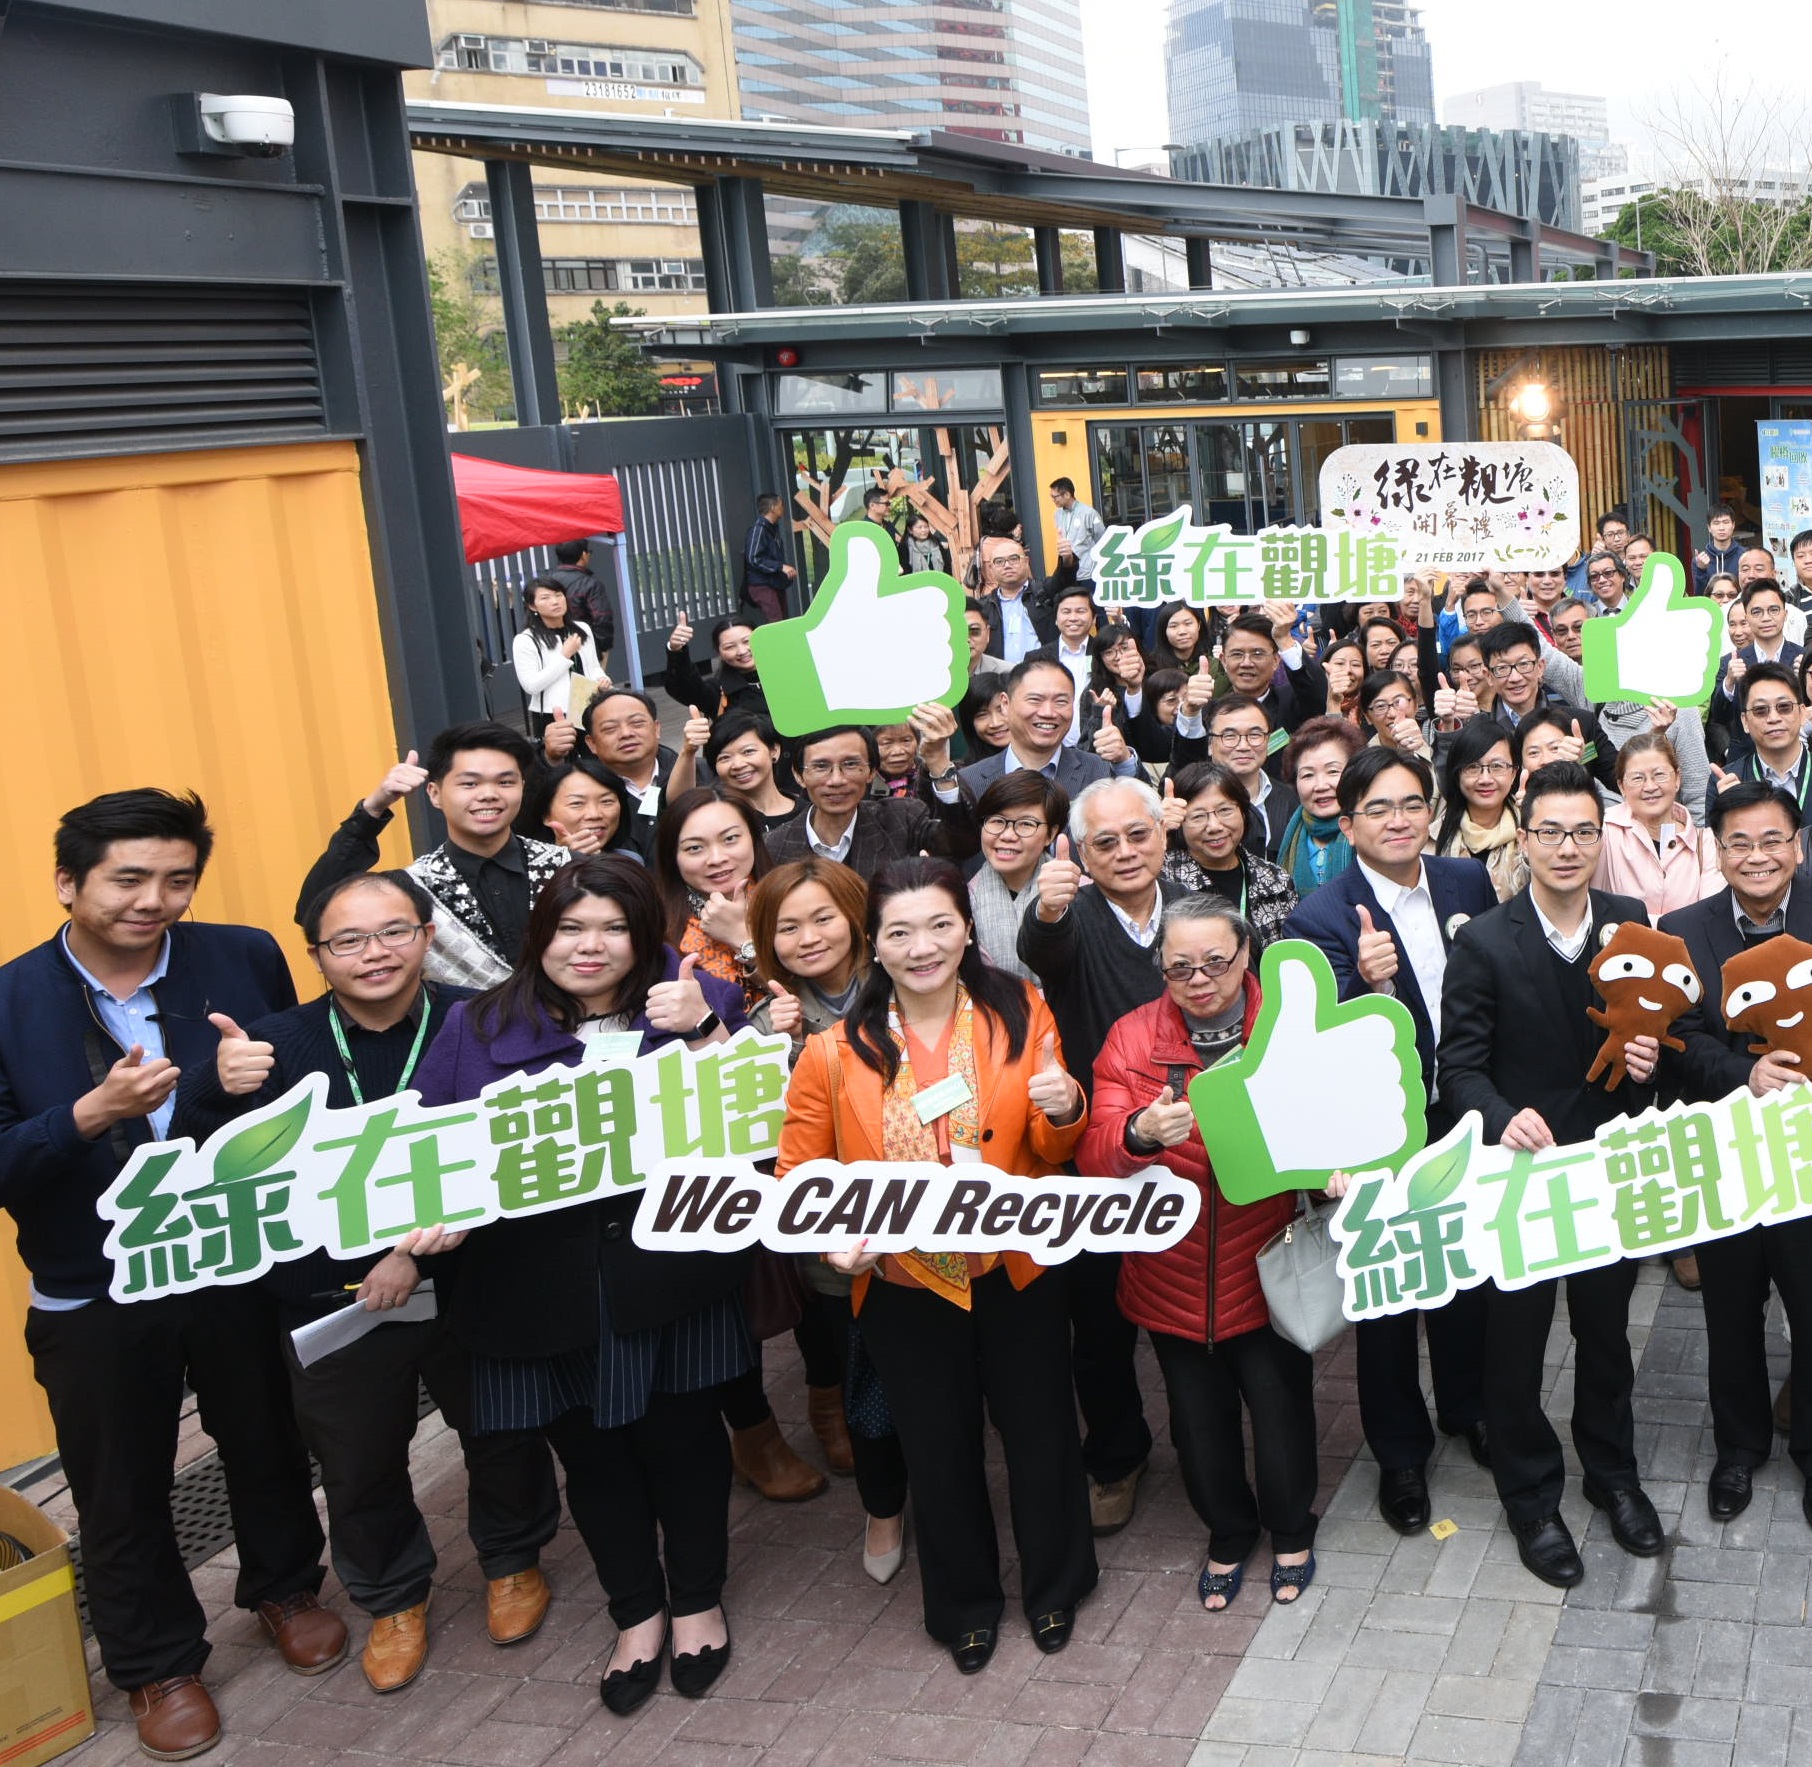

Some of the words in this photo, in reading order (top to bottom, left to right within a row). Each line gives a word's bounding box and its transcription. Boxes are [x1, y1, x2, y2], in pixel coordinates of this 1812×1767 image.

[584, 82, 637, 99] 23181652
[1413, 501, 1494, 543] 開幕禮
[1100, 516, 1399, 601] 綠在觀塘
[1415, 553, 1429, 563] 21
[1433, 552, 1454, 563] FEB
[1457, 552, 1485, 563] 2017
[115, 1036, 786, 1295] 綠在觀塘
[651, 1174, 761, 1235] We
[777, 1177, 929, 1235] CAN
[933, 1179, 1185, 1248] Recycle
